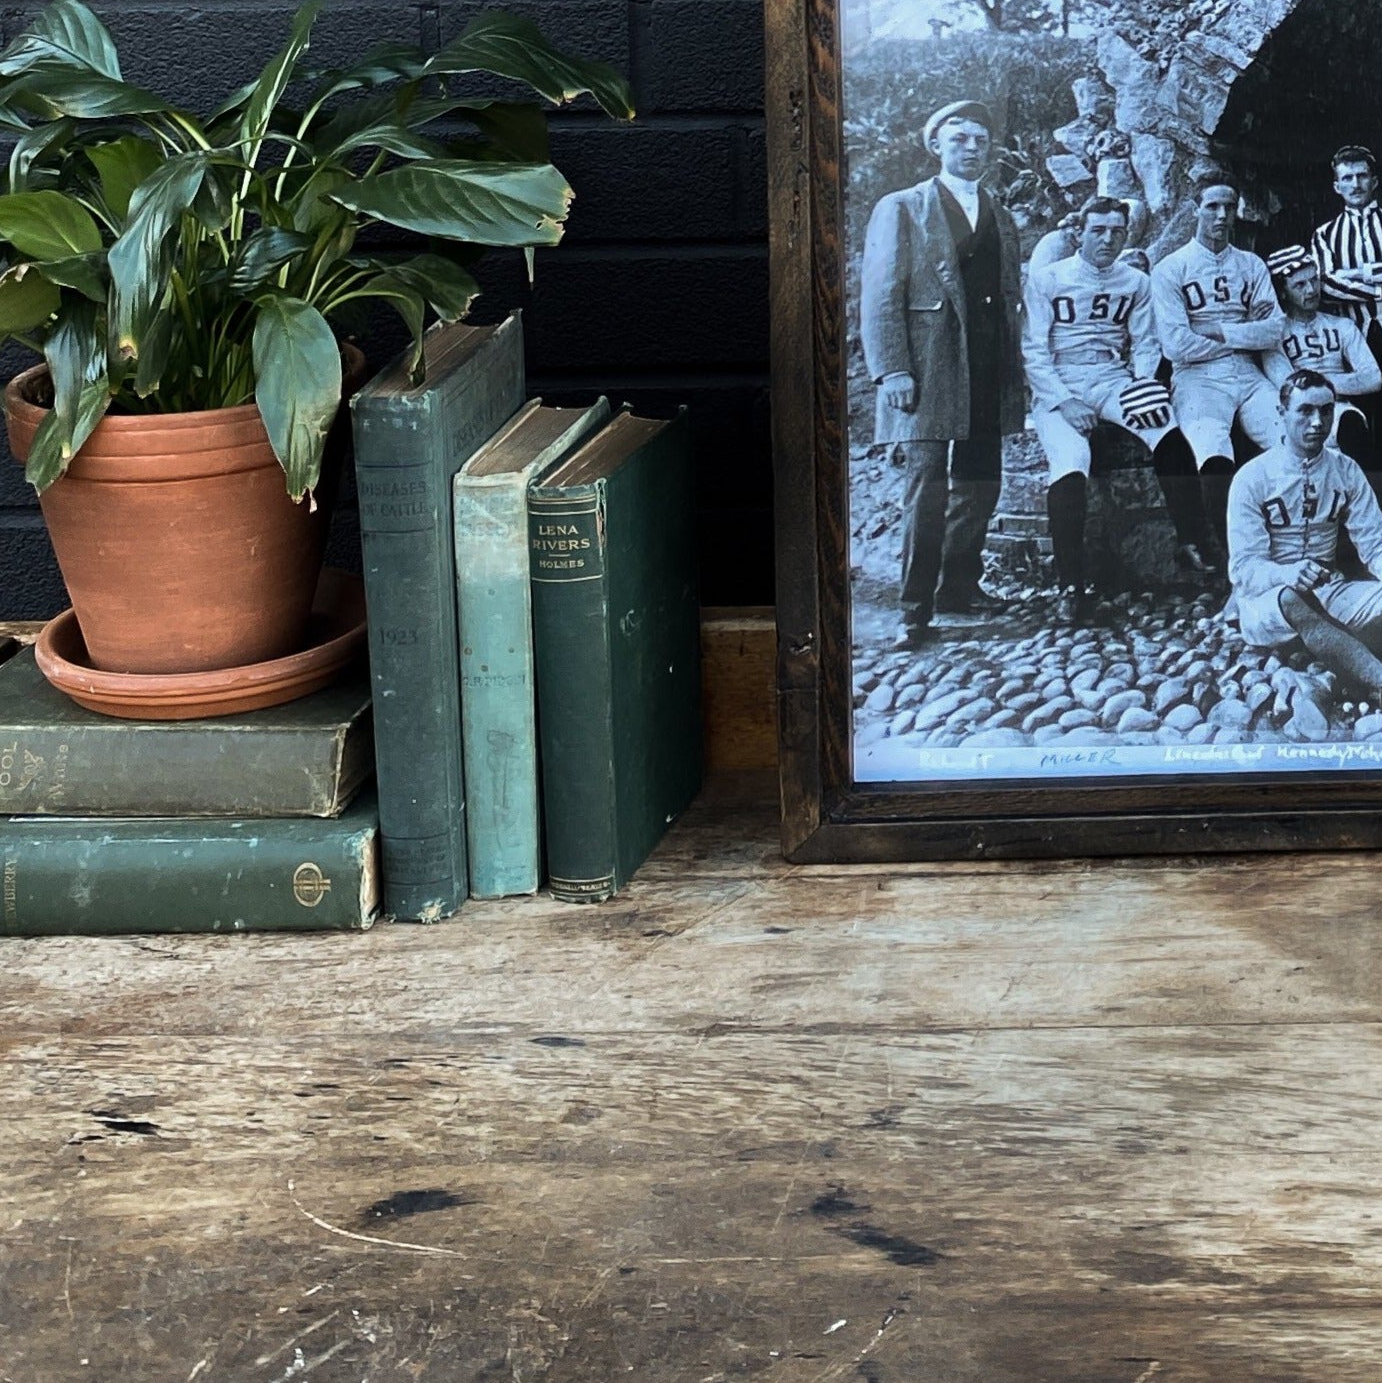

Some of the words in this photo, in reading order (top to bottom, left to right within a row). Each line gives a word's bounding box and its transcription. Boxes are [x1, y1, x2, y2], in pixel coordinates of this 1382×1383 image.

[1181, 275, 1256, 311] OSU
[1052, 293, 1136, 324] OSU
[1282, 328, 1340, 361] OSU
[539, 525, 580, 536] LENA
[532, 538, 591, 551] RIVERS
[539, 559, 585, 569] HOLMES
[380, 627, 417, 646] 1923
[1040, 748, 1122, 768] MILLER
